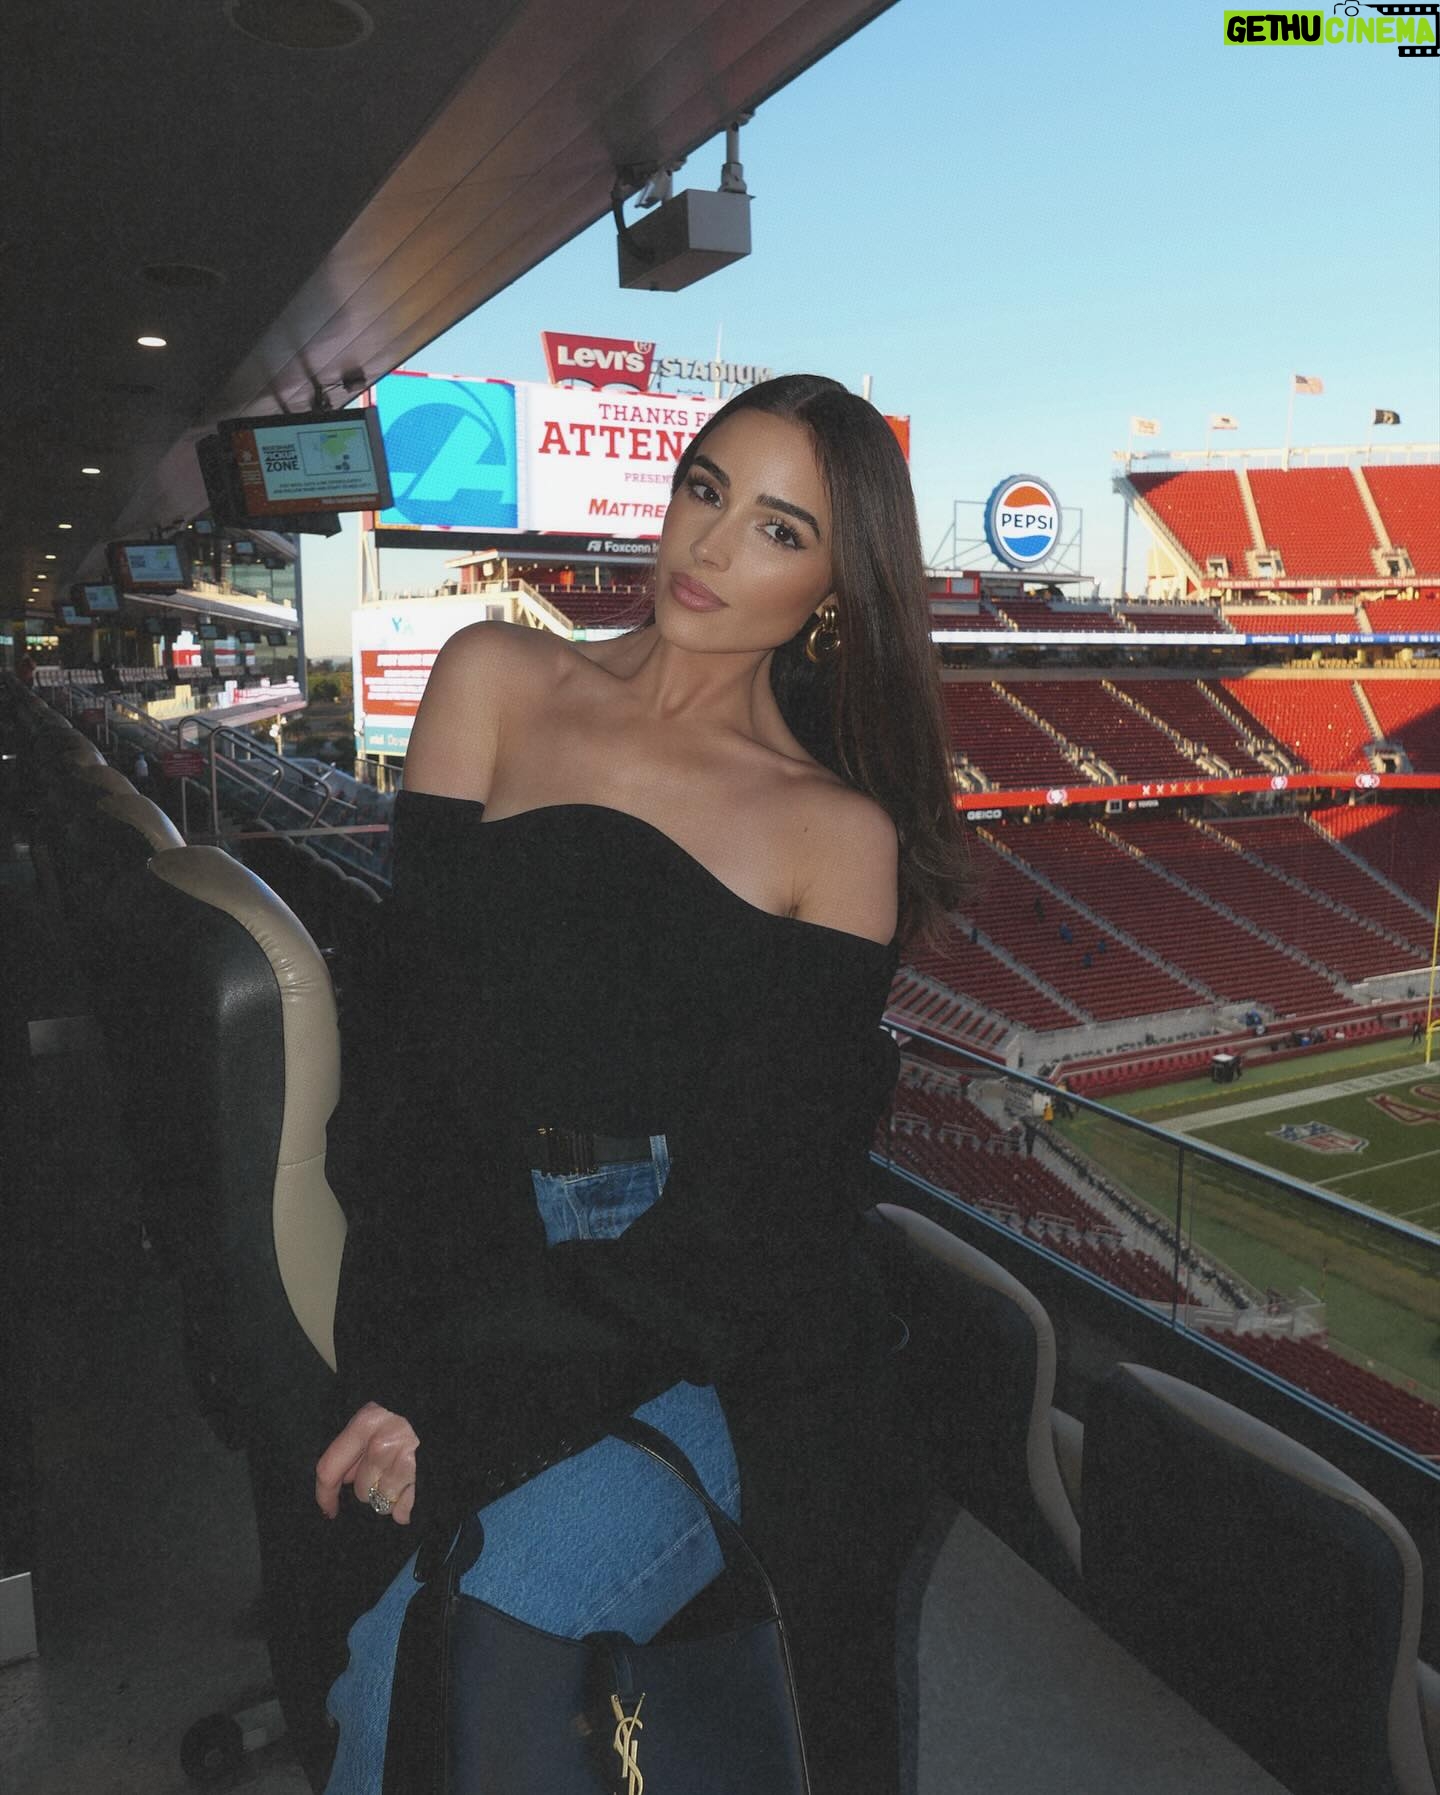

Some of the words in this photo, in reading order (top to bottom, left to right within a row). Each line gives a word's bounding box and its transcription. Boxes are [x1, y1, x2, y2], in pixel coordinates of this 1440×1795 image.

[557, 345, 646, 373] Levi's
[659, 358, 772, 385] STADIUM
[599, 403, 689, 427] THANKS
[695, 411, 716, 427] F
[538, 421, 698, 463] ATTEN
[266, 460, 300, 473] ZONE
[624, 472, 674, 485] PRESEN
[588, 498, 667, 519] MATTRE
[1001, 513, 1053, 530] PEPSI
[604, 540, 651, 553] Foxconn
[967, 809, 1003, 820] GEICO
